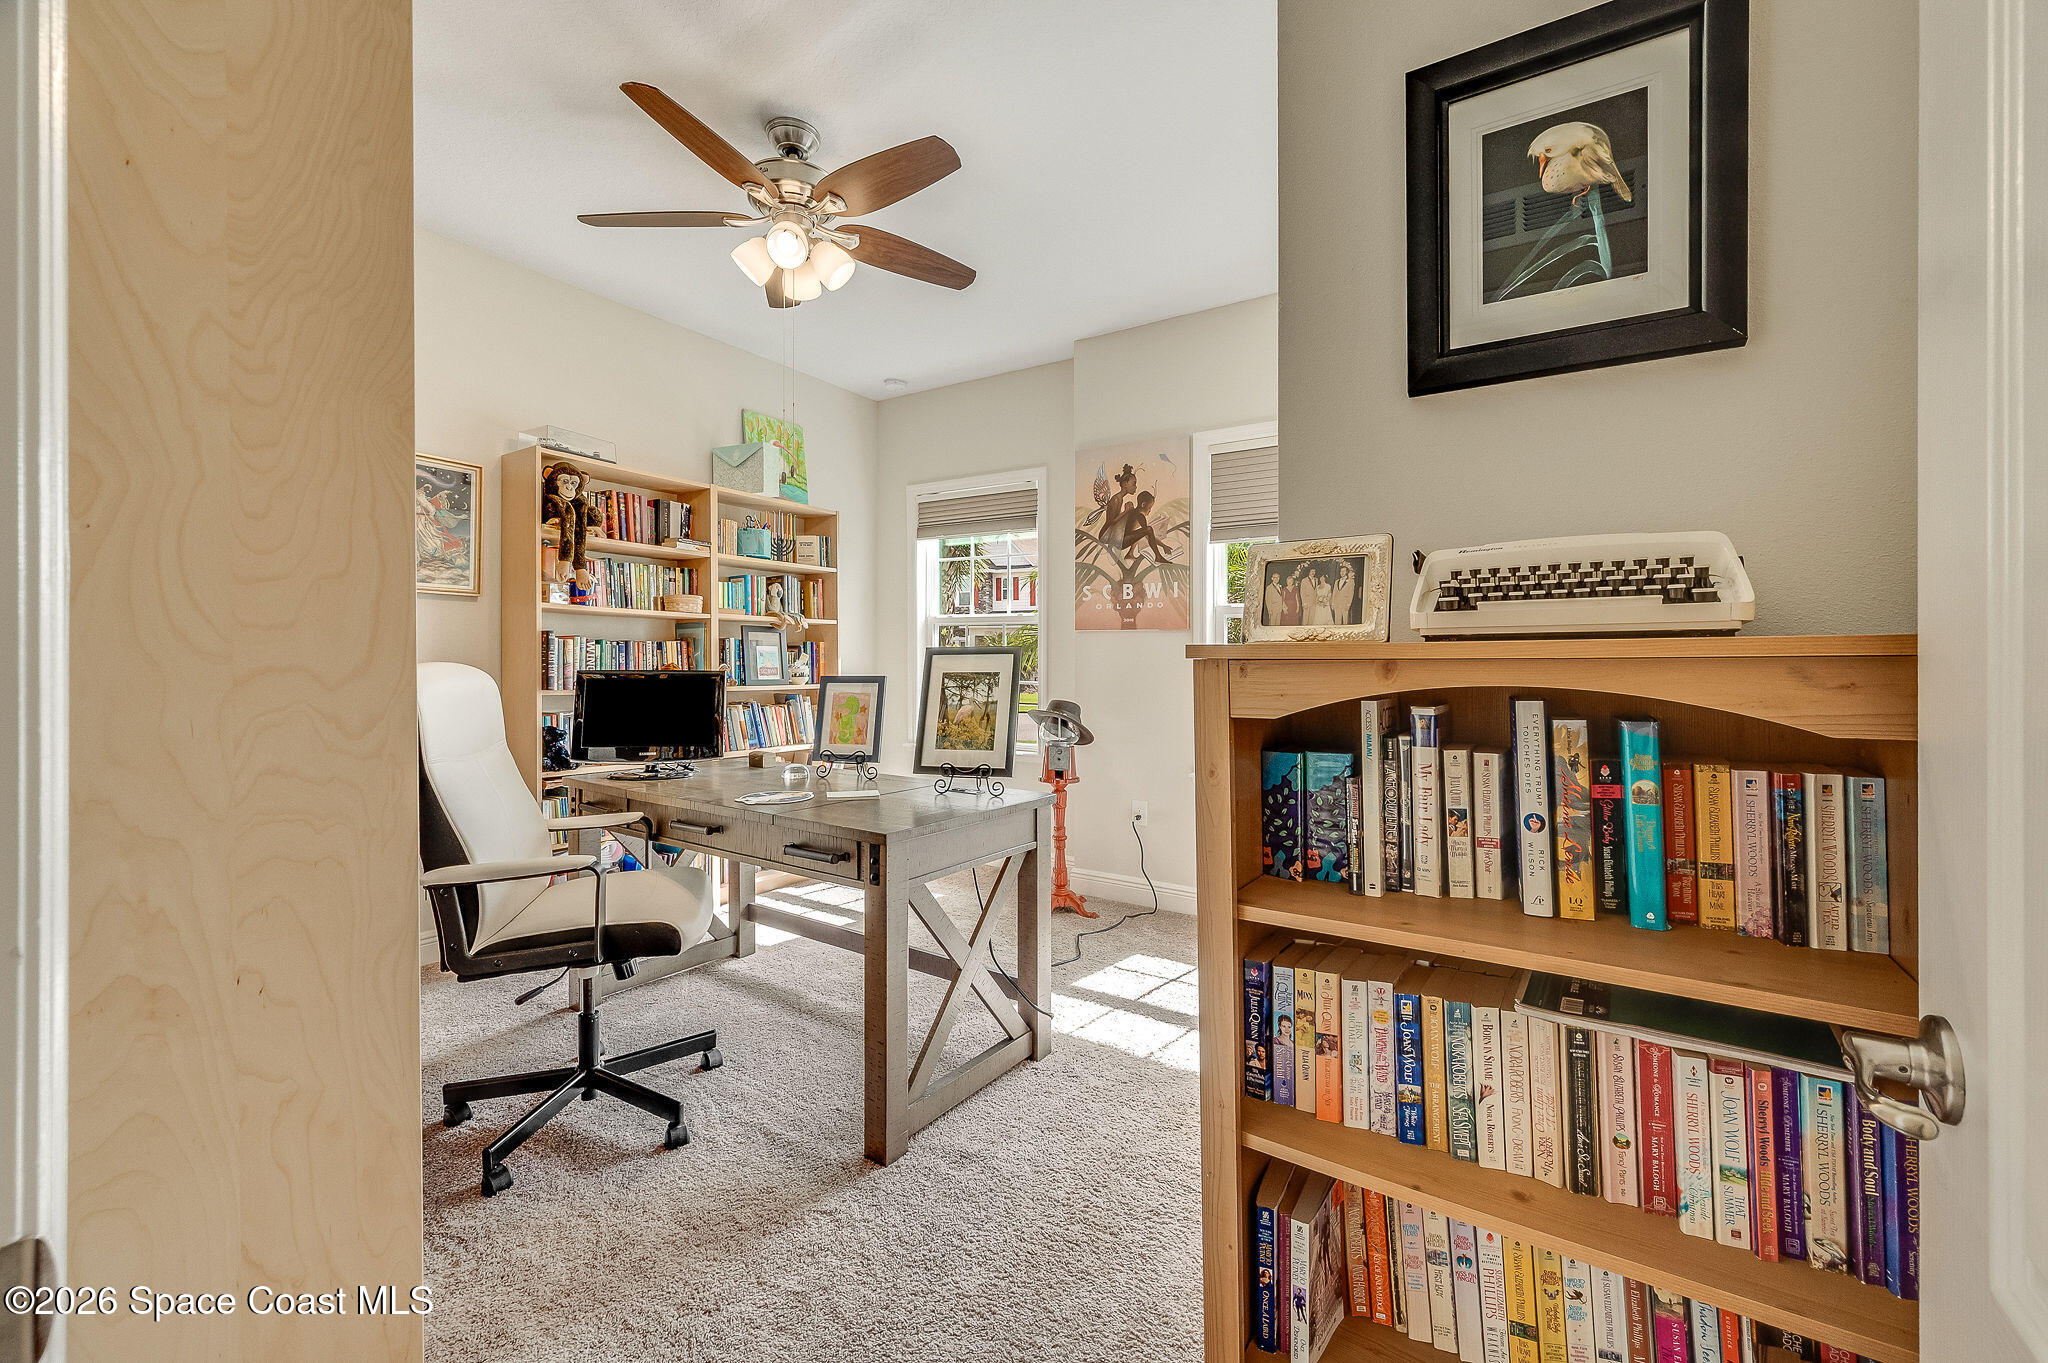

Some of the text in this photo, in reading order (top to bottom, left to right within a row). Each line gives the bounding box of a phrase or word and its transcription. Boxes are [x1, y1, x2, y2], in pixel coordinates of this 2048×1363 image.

[1082, 581, 1178, 601] SCBWI
[1095, 602, 1164, 610] ORLANDO
[1365, 709, 1374, 731] ACCESS
[1523, 726, 1532, 794] TOUCHES DIES
[1532, 714, 1543, 806] EVERYTHING TRUMP
[1448, 775, 1463, 806] JULIA QUINN
[1482, 772, 1491, 788] SUSAN
[1415, 763, 1434, 847] My Fair Lady
[1483, 789, 1492, 814] ELIZABETH
[1560, 768, 1582, 828] Sheine
[1600, 799, 1614, 821] Glitter
[1483, 815, 1493, 836] PHILLIPS
[1601, 822, 1614, 845] Baby
[1673, 784, 1686, 857] SUSAN ELIZABETH PHILLIPS
[1708, 787, 1721, 861] SUSAN ELIZABETH PHILLIPS
[1484, 849, 1494, 859] Hot
[1603, 846, 1613, 859] Susan
[1744, 800, 1758, 877] SHERRYL WOODS
[1821, 805, 1838, 881] SHERRYL WOODS
[1484, 860, 1494, 874] Shot
[1528, 842, 1536, 877] WILSON
[1538, 850, 1546, 872] RICK
[1561, 833, 1583, 885] Lende
[1604, 860, 1614, 880] Elizabeth
[1860, 806, 1876, 942] SHERRYL WOODS Seaview Inn
[1604, 881, 1615, 897] Phillips
[1747, 888, 1756, 911] Heaven
[1822, 908, 1832, 926] TEX
[1831, 903, 1840, 931] AFTER
[1274, 981, 1288, 1012] QUINN
[1248, 994, 1261, 1040] JULIA QUINN
[1348, 1012, 1357, 1049] MICHAELS
[1355, 1021, 1363, 1040] FERN
[1400, 1022, 1417, 1084] JOAN WOLF
[1430, 1019, 1440, 1070] JOAN WOLF
[1482, 1024, 1495, 1081] BORN IN SHAME
[1301, 1049, 1310, 1081] JULIA QUINN
[1450, 1036, 1468, 1100] NORA ROBERTS
[1509, 1044, 1525, 1104] NORA ROBERTS
[1534, 1087, 1544, 1111] Upon
[1612, 1053, 1627, 1132] SUSAN ELIZABETH PHILLIPS
[1431, 1089, 1440, 1144] ARRANGEMENT
[1453, 1106, 1471, 1150] SEA SWEPT
[1486, 1103, 1496, 1153] NORA ROBERTS
[1535, 1111, 1545, 1133] Once
[1720, 1091, 1741, 1163] JOAN WOLF
[1537, 1136, 1547, 1159] NORA
[1686, 1092, 1702, 1175] SHERRYL WOODS
[1512, 1138, 1525, 1163] DREAM
[1545, 1137, 1553, 1169] ROBERTS
[1651, 1136, 1661, 1191] MARY BALOGH
[1815, 1108, 1831, 1206] SHERRYL WOODS
[1860, 1119, 1879, 1196] Body and Soul
[1616, 1150, 1627, 1186] Fancy Pants
[1755, 1100, 1775, 1234] Sherryl Woods Hide and Seek
[1904, 1136, 1920, 1234] HERRYL WOODS
[1348, 1207, 1361, 1229] NORA
[1723, 1184, 1735, 1226] SUMMER
[1734, 1195, 1746, 1218] THAT
[1782, 1173, 1793, 1232] MARY BALOGH
[1513, 1252, 1524, 1269] SUSAN
[1262, 1290, 1270, 1311] ONCE
[1354, 1282, 1367, 1305] HARBOR
[1483, 1267, 1498, 1320] PHILLIPS
[1494, 1269, 1506, 1321] SUSAN ELIZABETH
[1630, 1290, 1643, 1320] Elizabeth
[1515, 1298, 1526, 1322] PHILLIPS
[1602, 1282, 1615, 1349] SUSAN ELIZABETH PHILLIPS
[1261, 1317, 1270, 1339] LAIRD
[1632, 1322, 1645, 1349] Phillips
[1671, 1322, 1680, 1352] SUSAN
